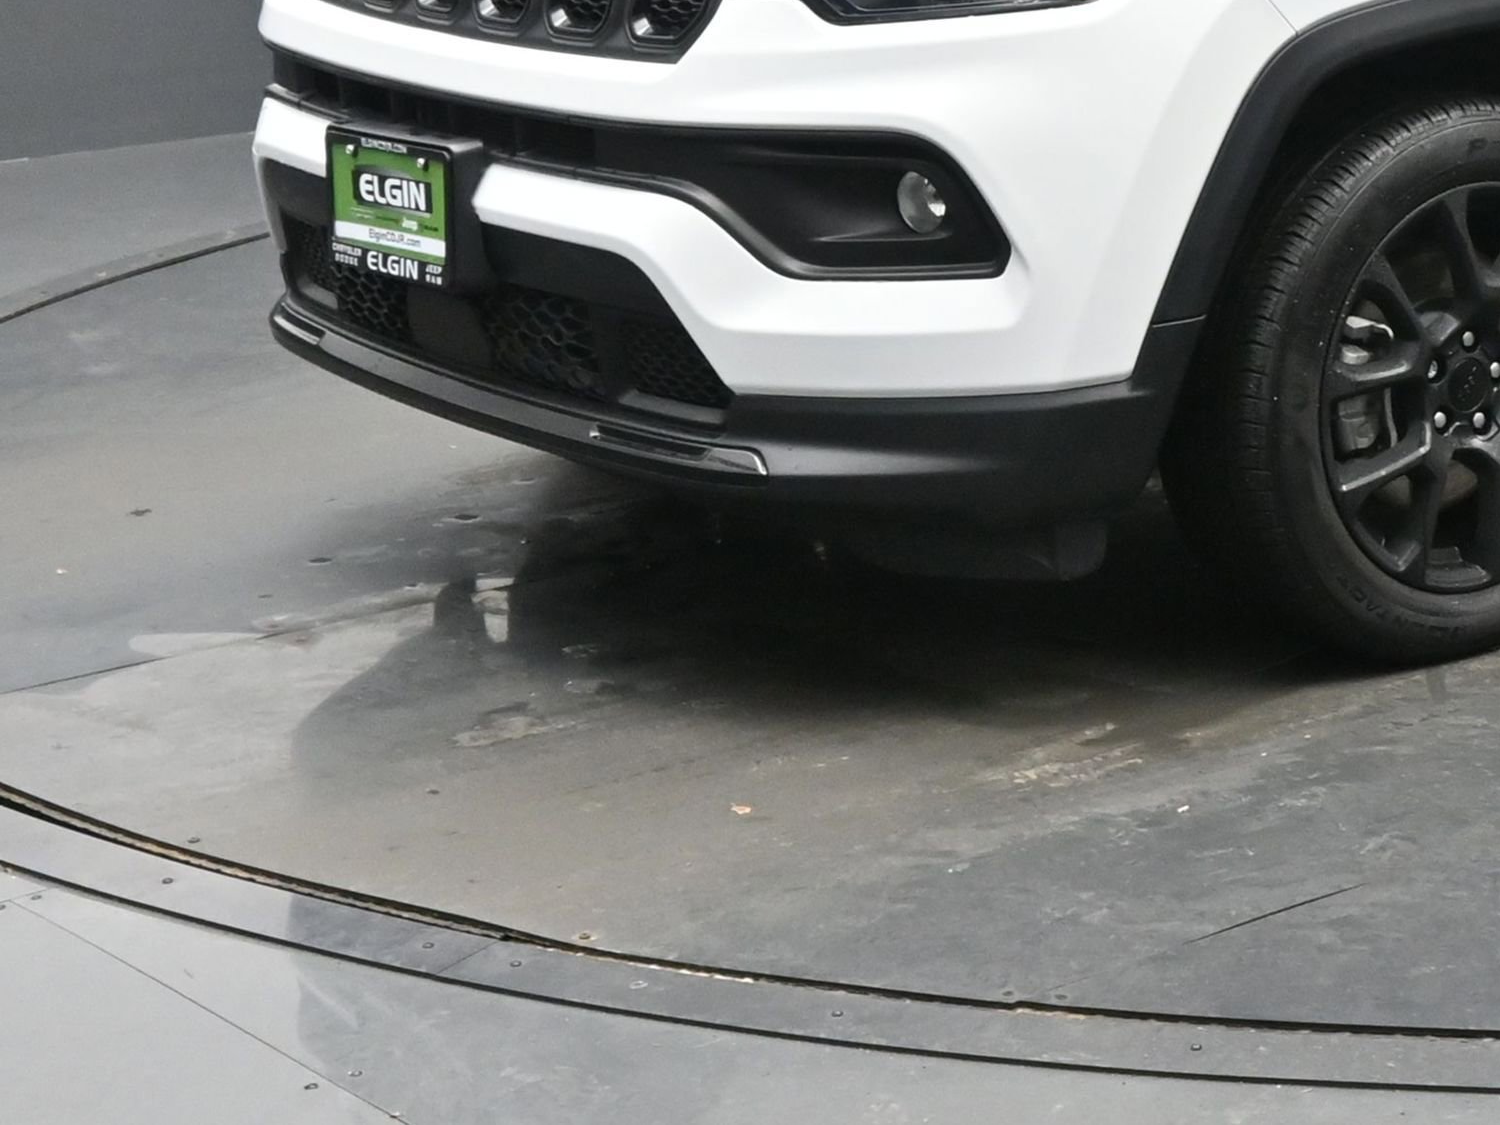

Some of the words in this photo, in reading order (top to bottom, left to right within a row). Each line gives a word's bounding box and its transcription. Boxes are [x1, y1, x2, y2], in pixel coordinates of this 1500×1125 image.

[359, 173, 427, 211] ELGIN
[332, 242, 362, 257] CHRYSLER
[335, 253, 358, 266] DODGE
[366, 251, 419, 281] ELGIN
[425, 264, 443, 275] JEEP
[425, 275, 443, 286] RAM
